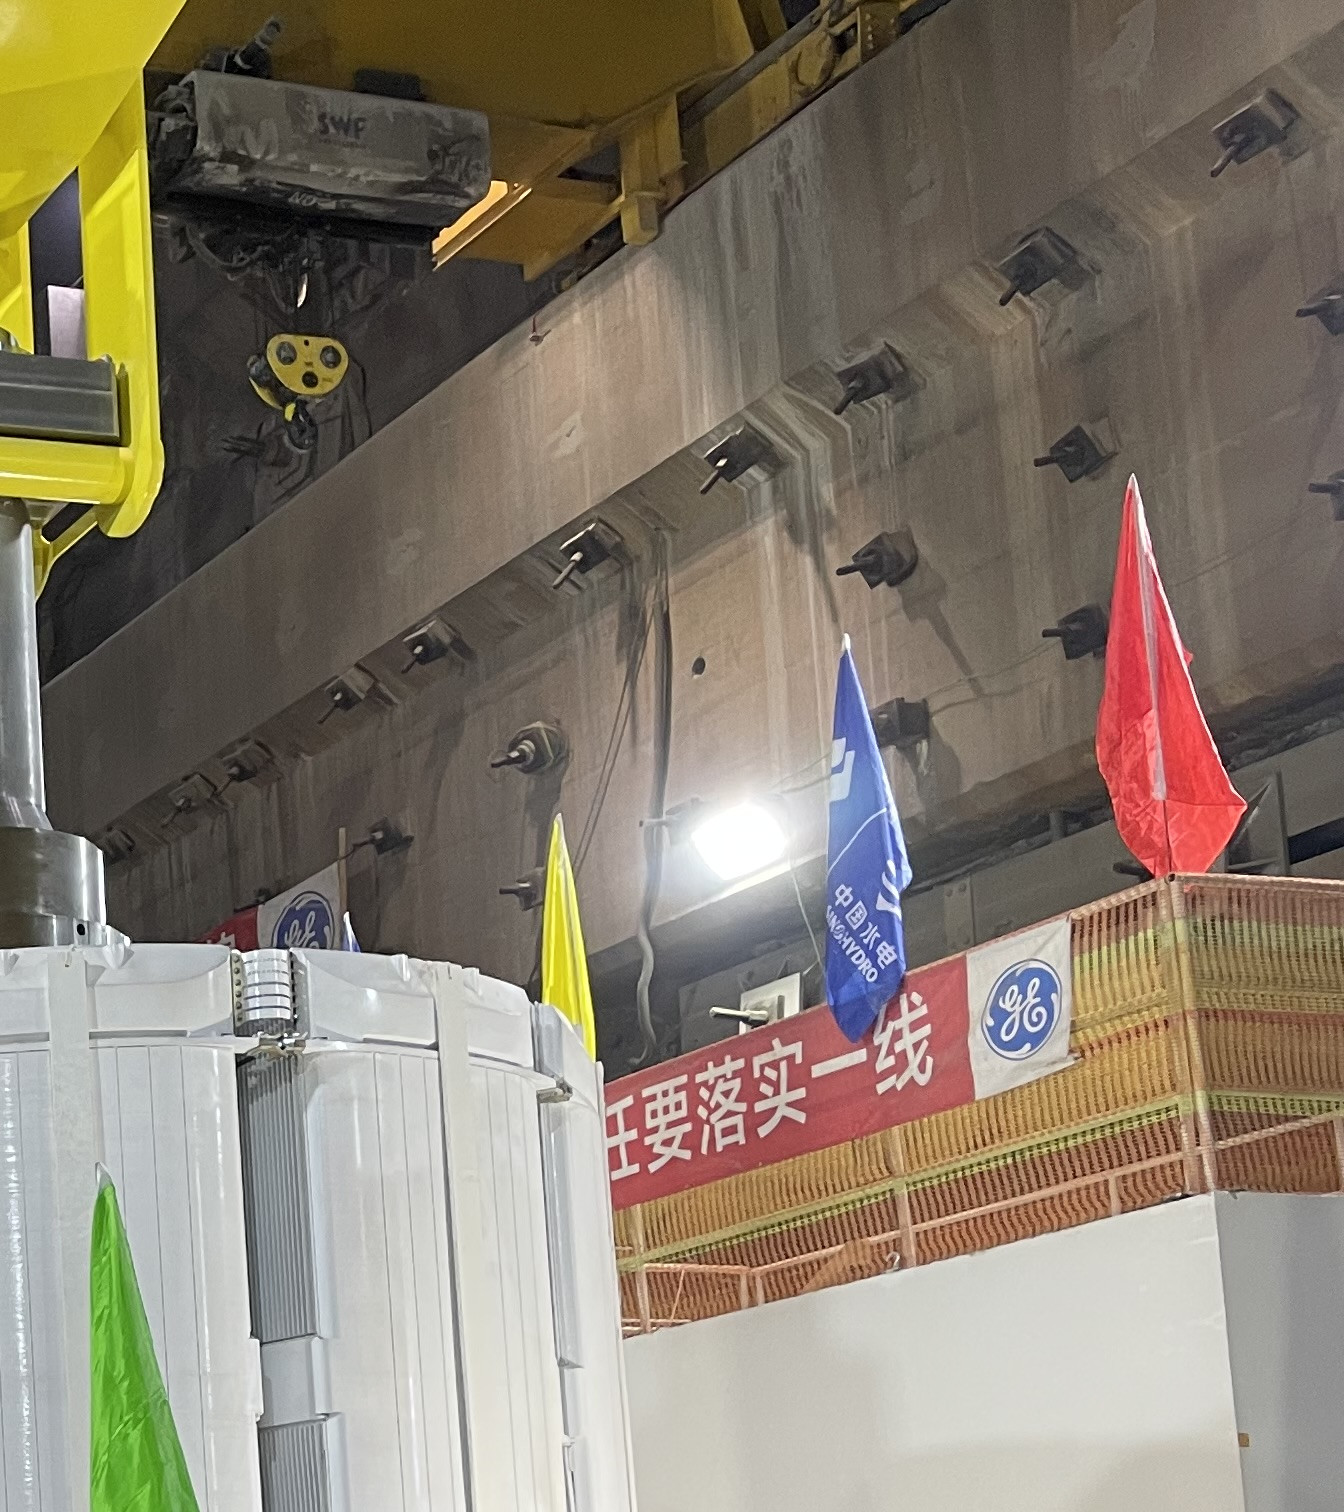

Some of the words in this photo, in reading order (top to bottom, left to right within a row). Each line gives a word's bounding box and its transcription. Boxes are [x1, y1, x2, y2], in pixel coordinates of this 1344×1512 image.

[317, 112, 367, 140] SWF
[835, 884, 898, 971] 中国水电
